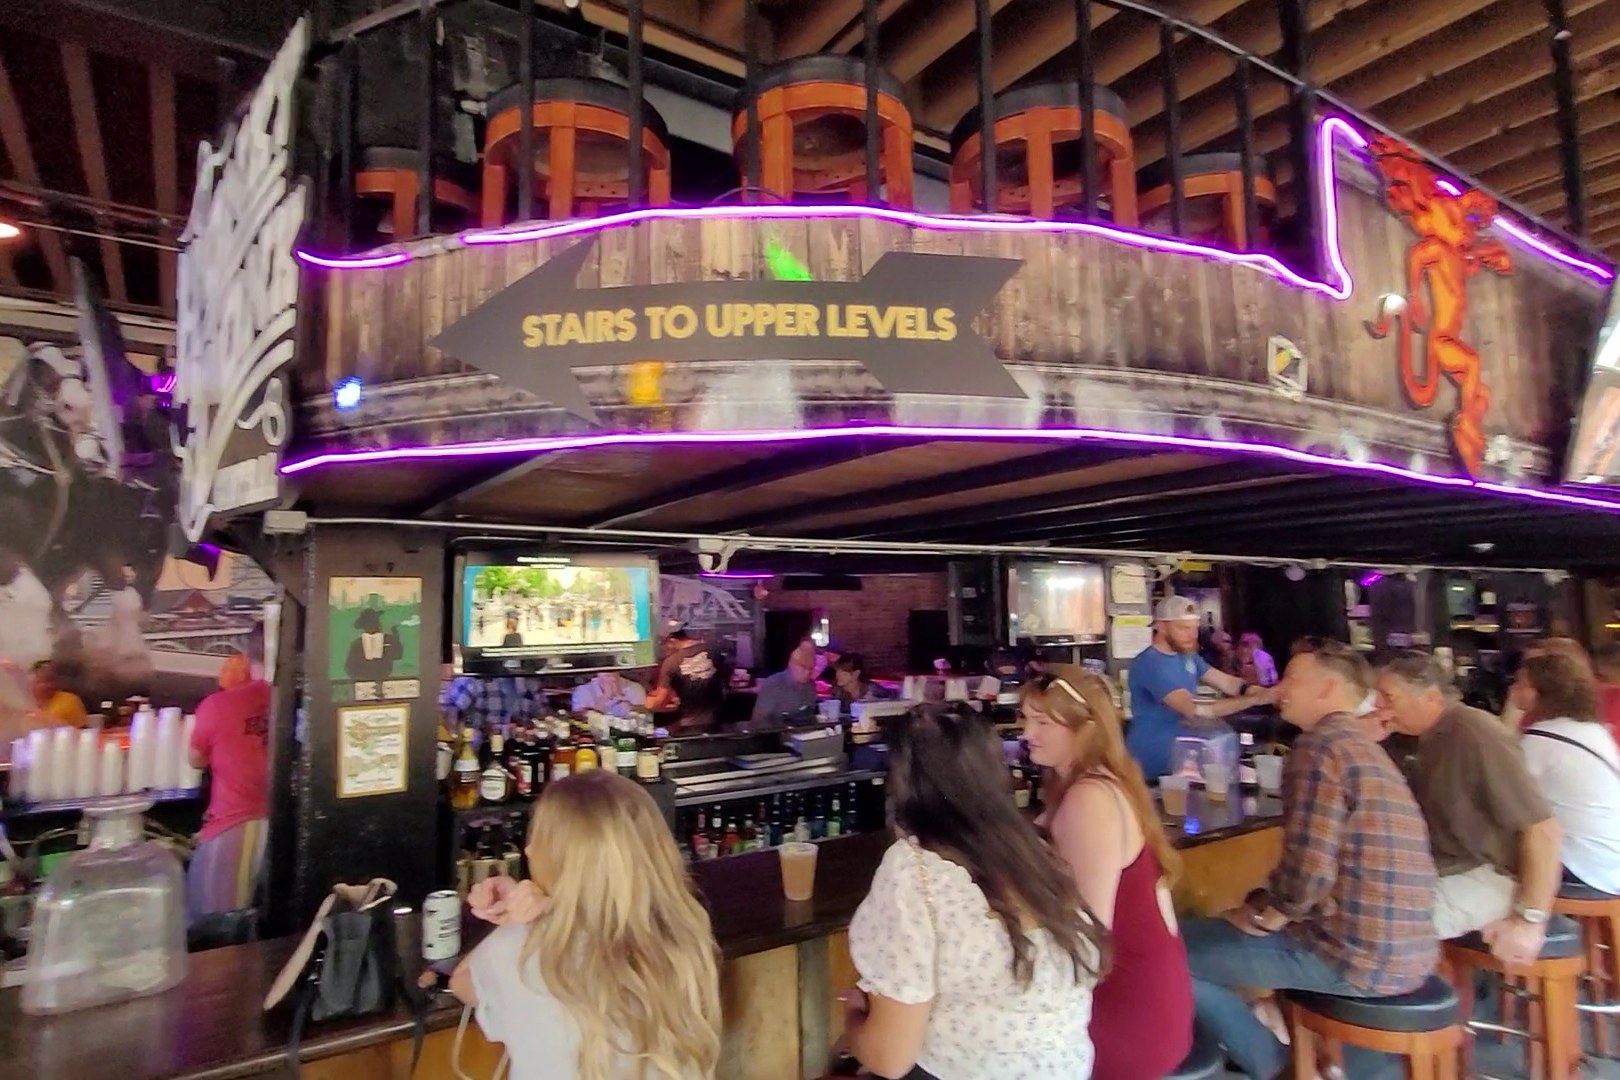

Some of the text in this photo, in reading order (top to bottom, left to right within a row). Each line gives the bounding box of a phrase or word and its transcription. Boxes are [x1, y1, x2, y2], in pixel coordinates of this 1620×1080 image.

[522, 303, 957, 347] STAIRS TO UPPER LEVELS
